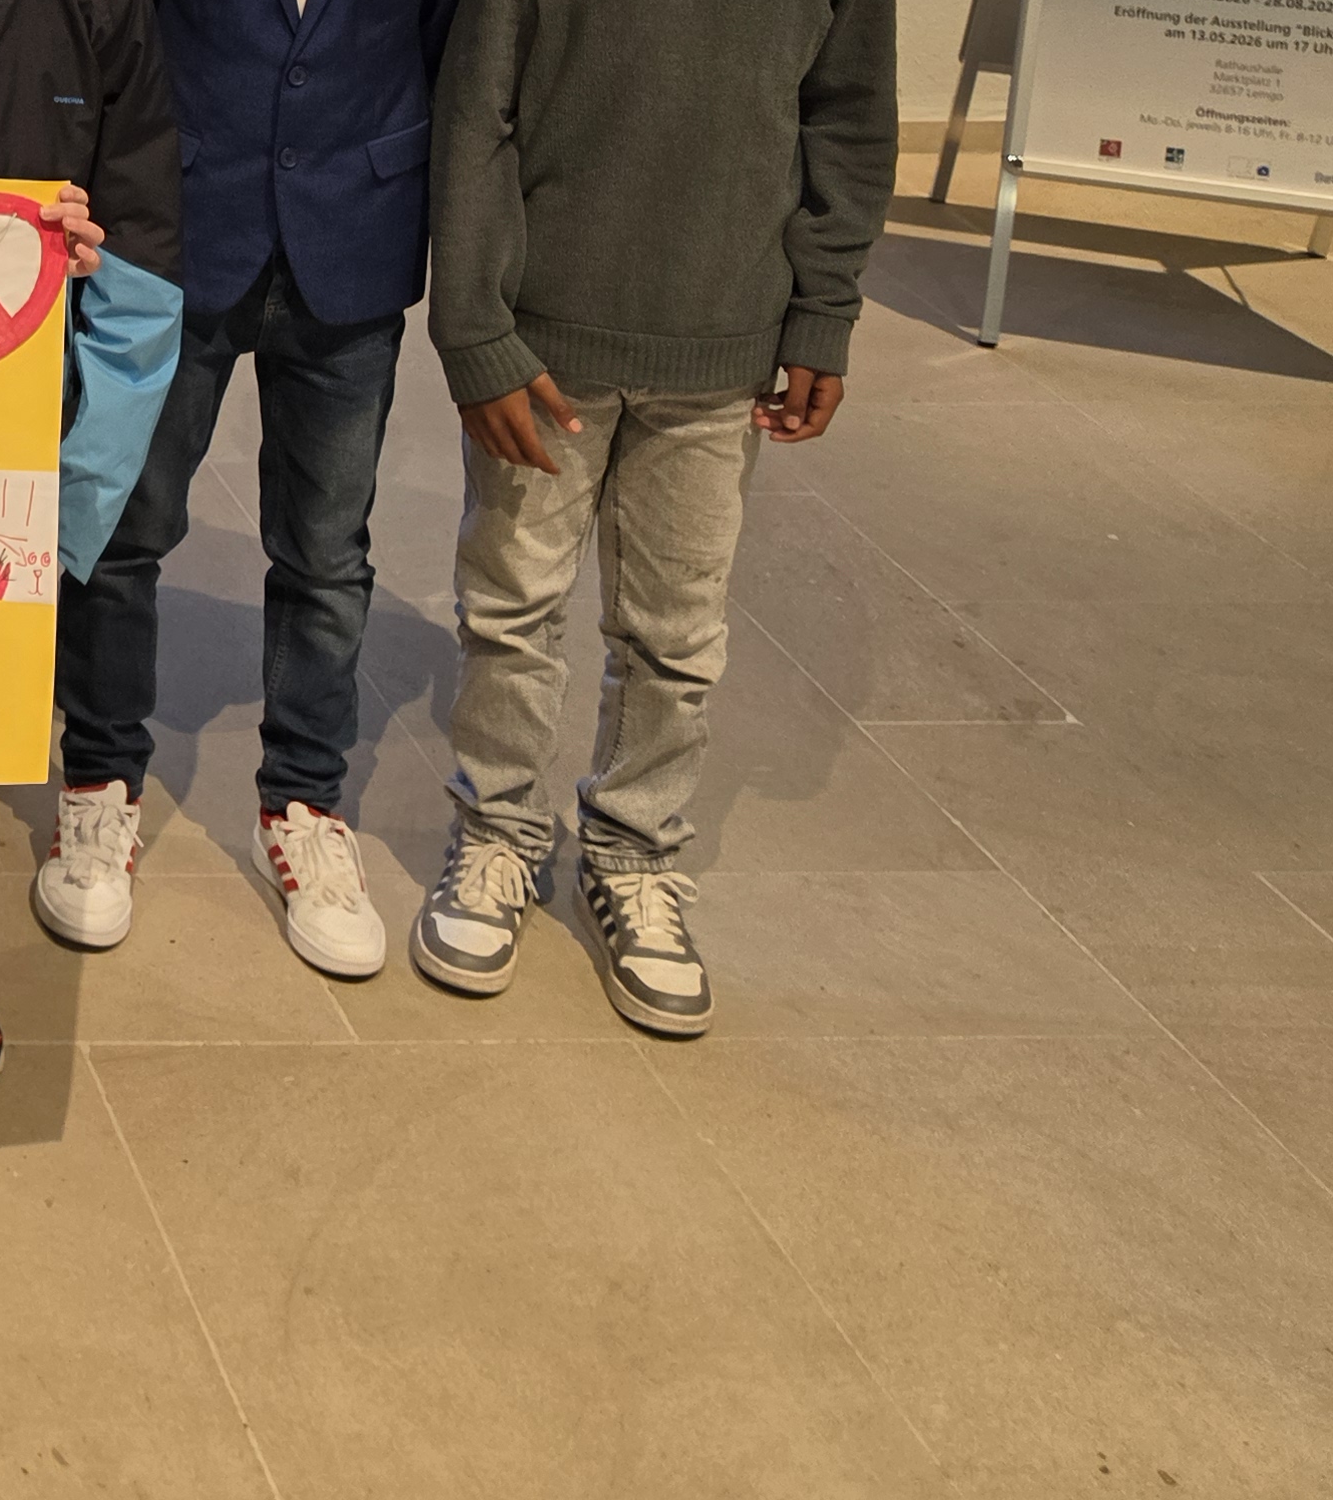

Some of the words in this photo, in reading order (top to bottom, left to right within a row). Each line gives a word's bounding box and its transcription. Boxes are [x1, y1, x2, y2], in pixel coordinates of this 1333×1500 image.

[1114, 5, 1181, 25] Eröffnung
[1184, 12, 1208, 26] der
[1210, 16, 1291, 37] Ausstellung
[1164, 29, 1185, 39] am
[1190, 29, 1262, 48] 13.05.2026
[1266, 39, 1288, 51] um
[1294, 41, 1309, 52] 17
[1213, 72, 1271, 88] Marktplatz
[1195, 106, 1291, 127] Öffnungszeiten:
